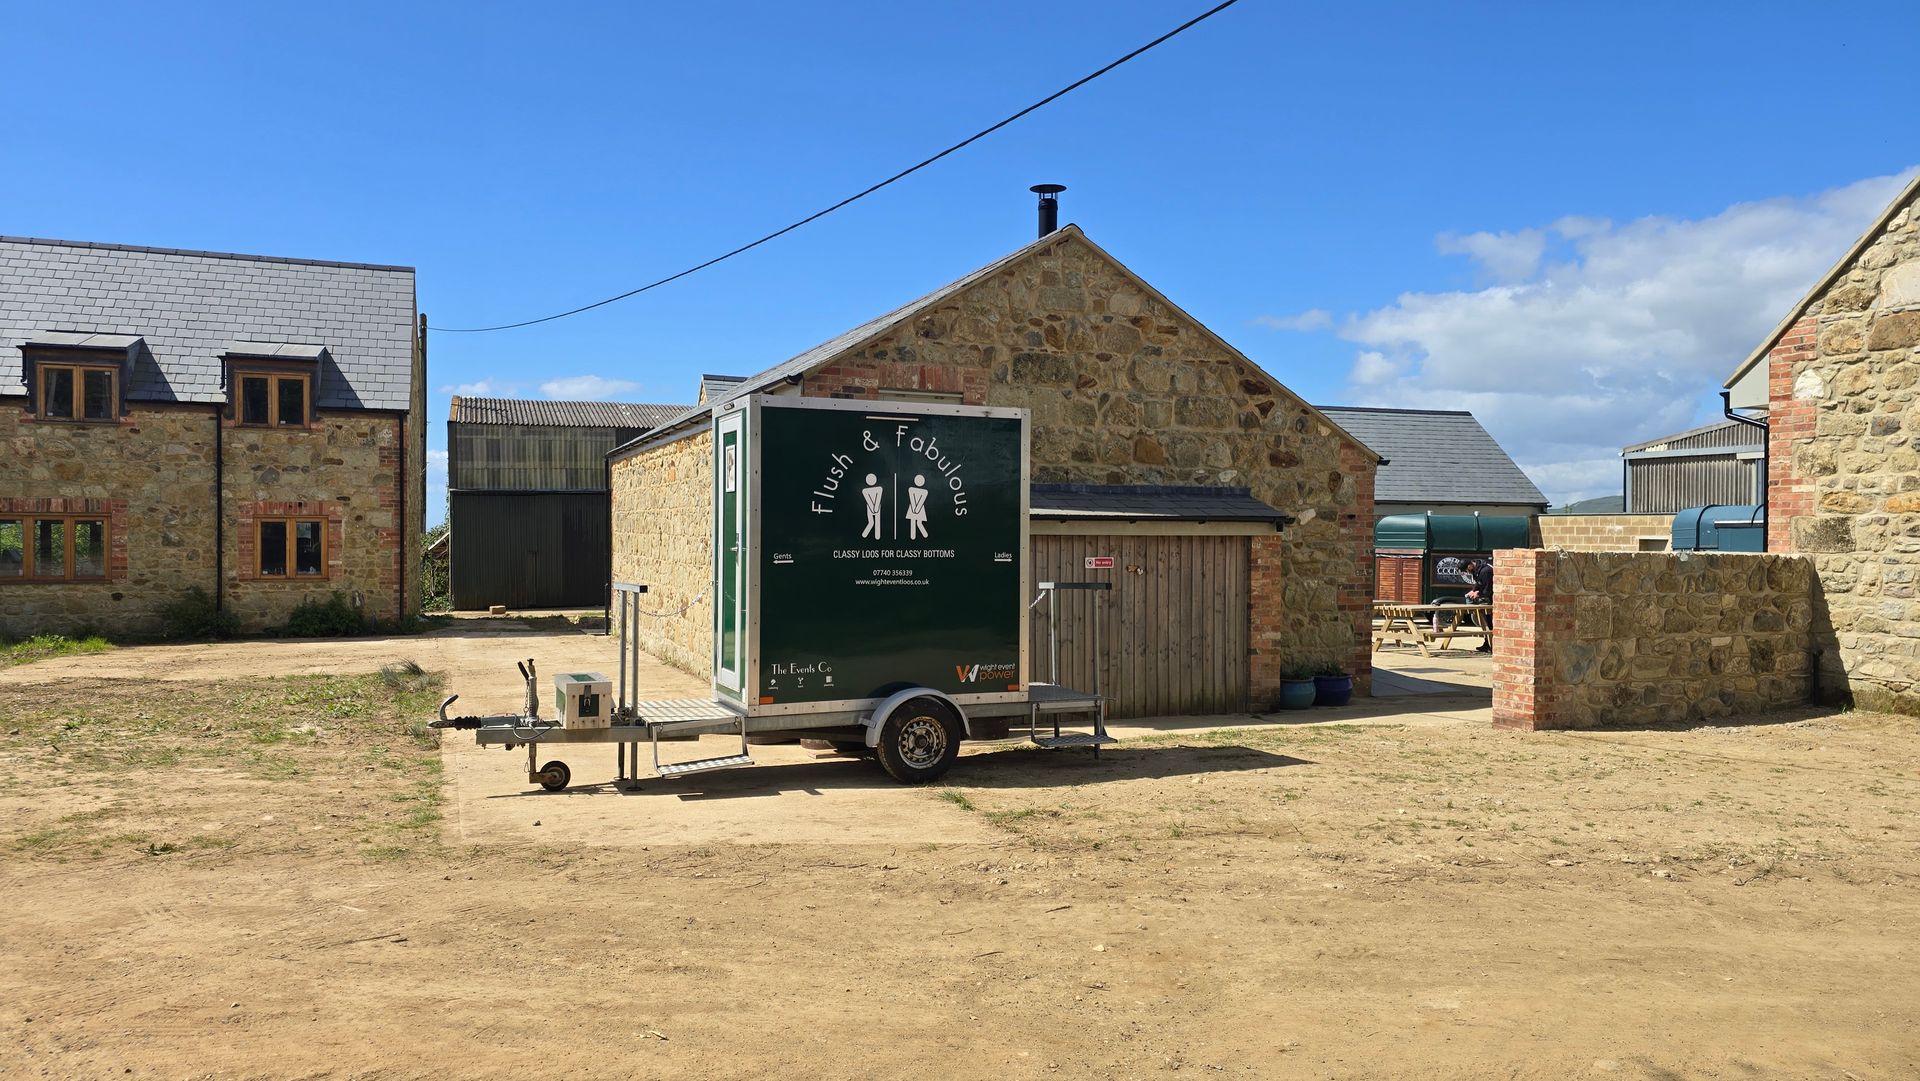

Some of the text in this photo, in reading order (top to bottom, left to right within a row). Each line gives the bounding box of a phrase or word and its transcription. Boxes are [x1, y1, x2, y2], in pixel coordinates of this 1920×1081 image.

[811, 425, 968, 517] Flush & Fabulous
[773, 552, 792, 560] Gents
[833, 549, 955, 559] CLASSY LOOS FOR CLASSY BOTTOMS
[994, 551, 1012, 559] Ladies
[771, 661, 832, 675] The Events Co
[980, 671, 1015, 682] power
